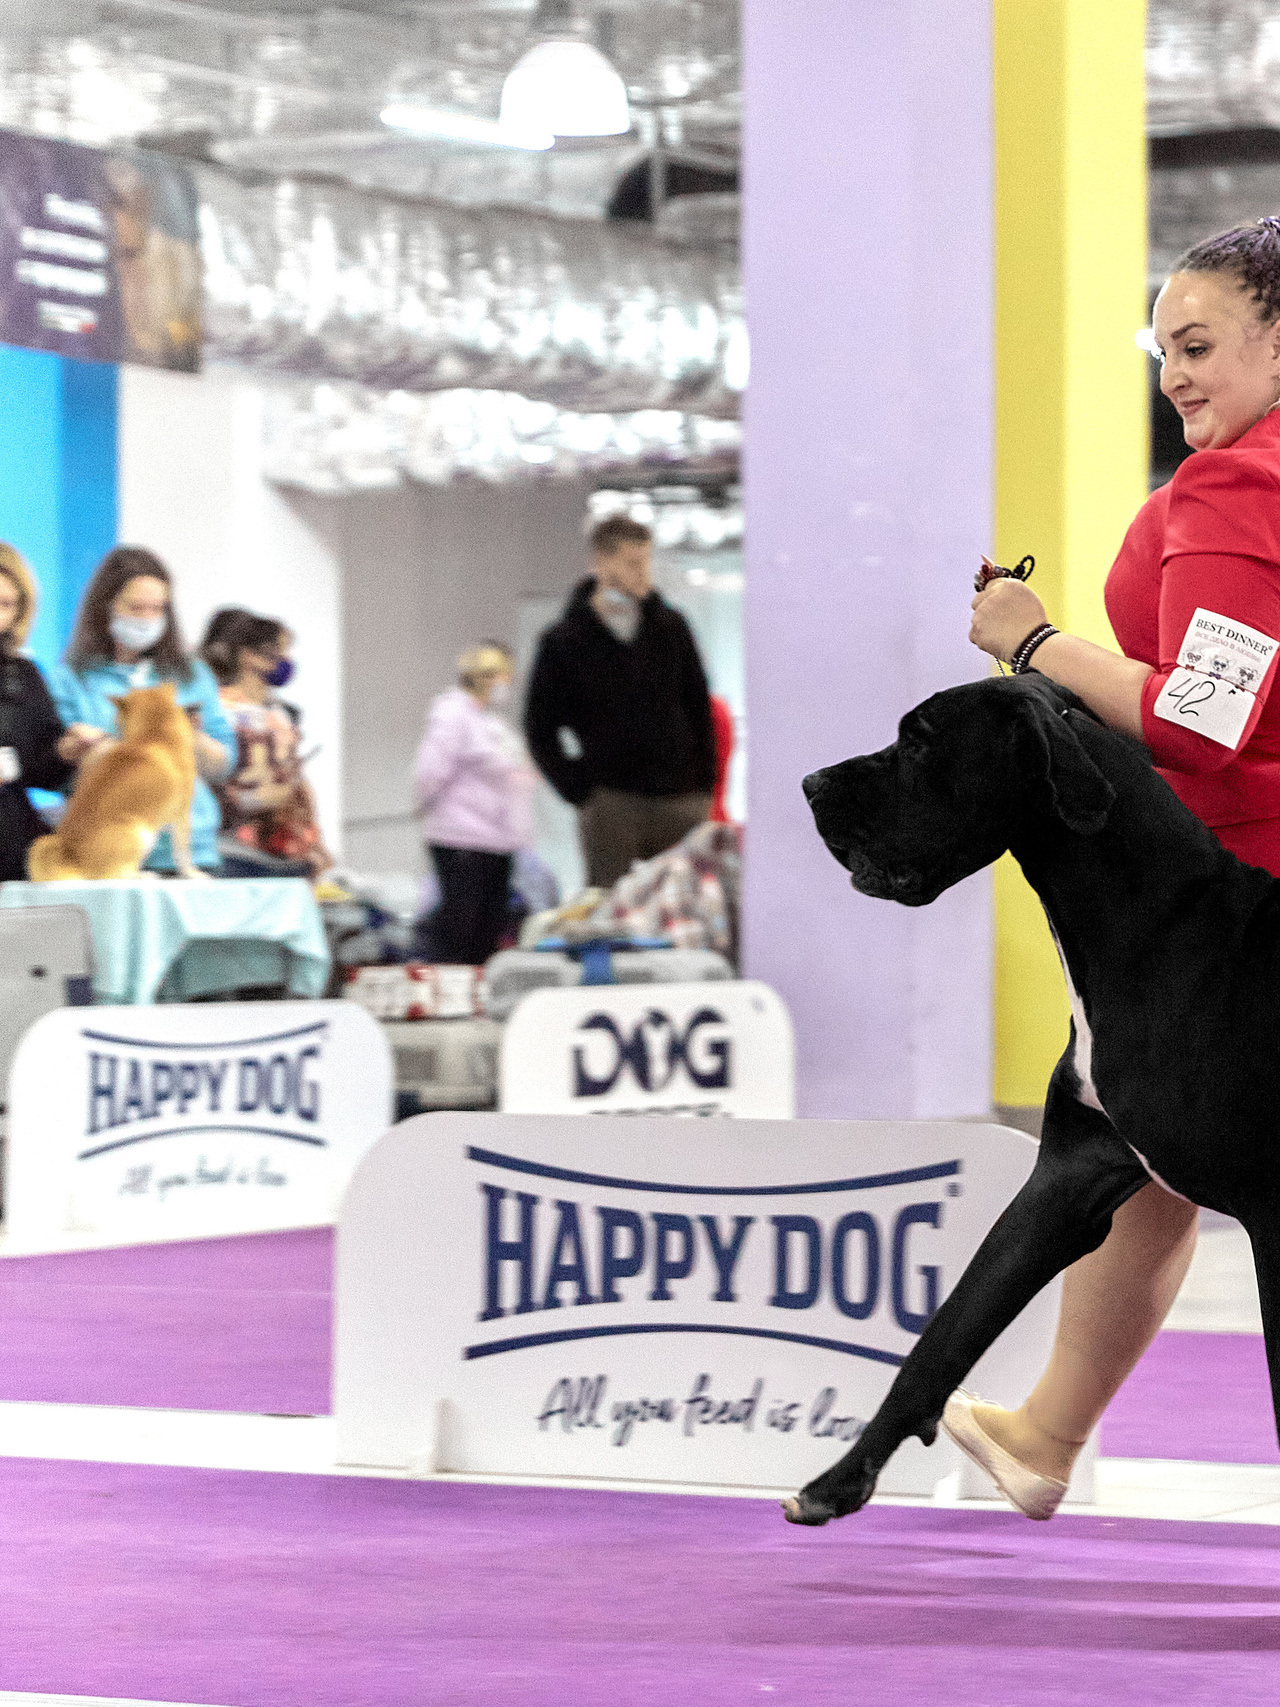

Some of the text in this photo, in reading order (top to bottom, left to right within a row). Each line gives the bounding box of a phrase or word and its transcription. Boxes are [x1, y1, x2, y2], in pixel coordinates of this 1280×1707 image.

[1196, 618, 1225, 635] BEST
[1167, 677, 1216, 717] 42
[86, 1044, 321, 1136] HAPPY DOG
[572, 1005, 732, 1098] DOG
[475, 1182, 943, 1336] HAPPY DOG
[537, 1373, 608, 1434] All
[611, 1397, 675, 1447] you
[683, 1372, 764, 1438] feed
[766, 1398, 801, 1433] is
